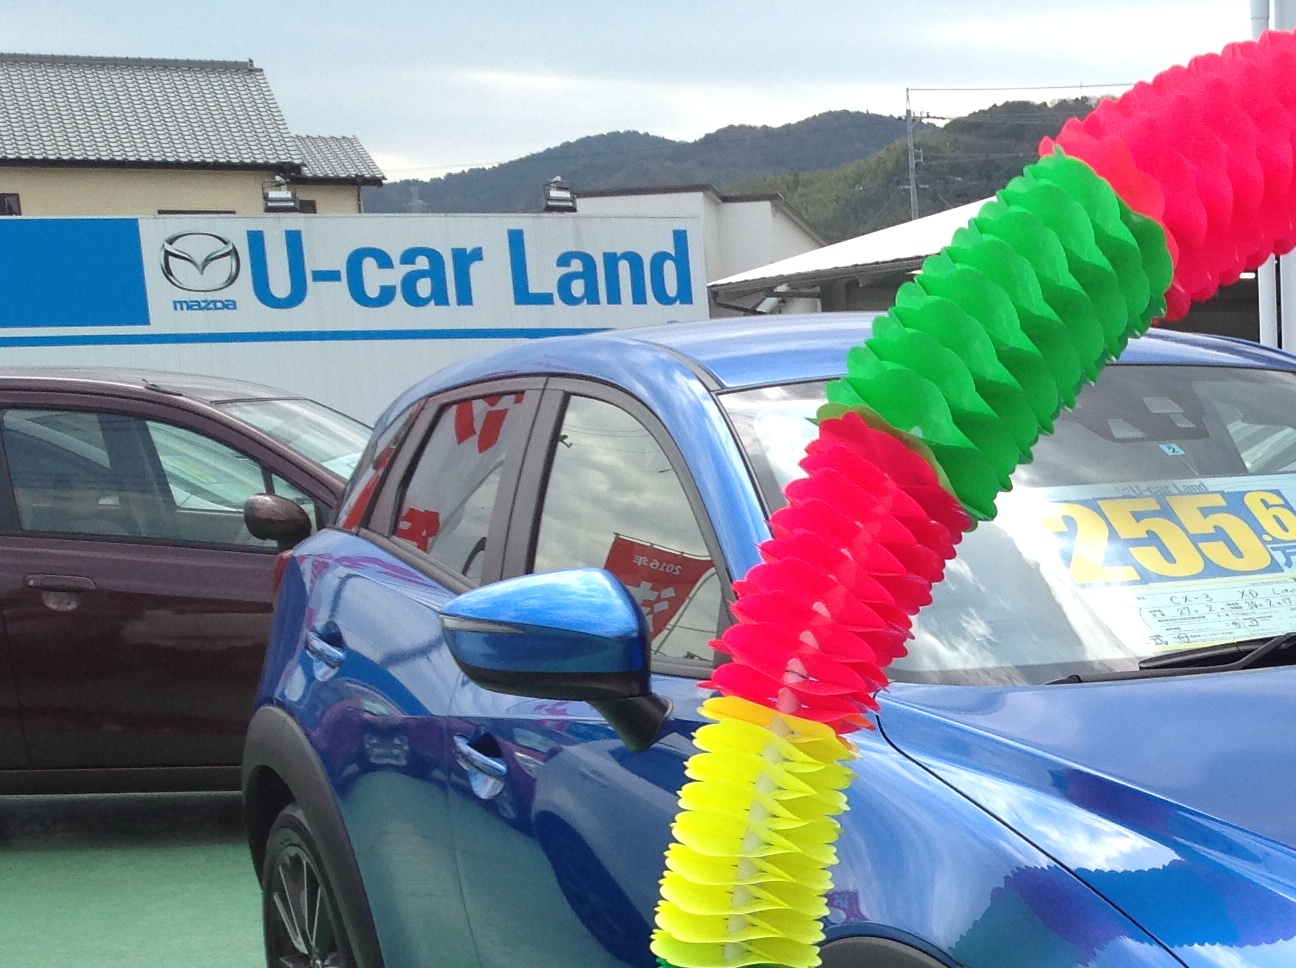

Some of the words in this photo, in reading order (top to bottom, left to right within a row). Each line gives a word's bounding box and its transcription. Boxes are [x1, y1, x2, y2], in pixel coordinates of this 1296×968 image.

[246, 229, 483, 309] U-car
[507, 228, 693, 306] Land
[1172, 481, 1210, 494] Land
